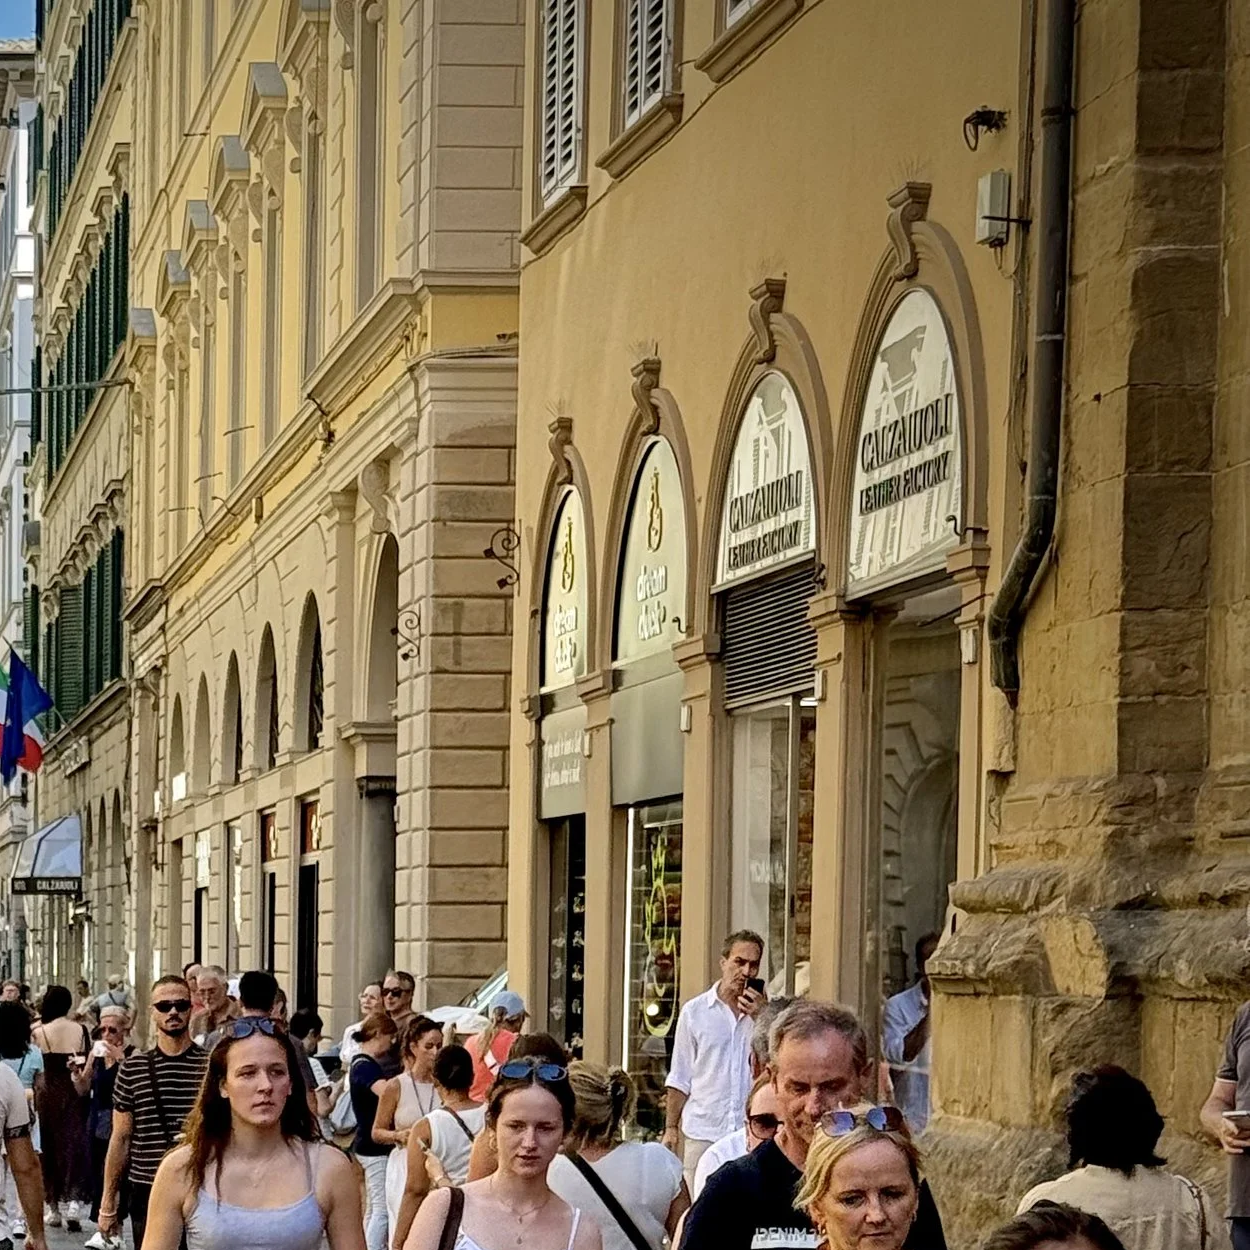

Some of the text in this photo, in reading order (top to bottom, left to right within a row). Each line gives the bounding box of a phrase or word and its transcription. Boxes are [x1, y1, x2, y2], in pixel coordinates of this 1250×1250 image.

[861, 393, 954, 474] CALZAIUOLI
[730, 470, 803, 533] CALZAIUOLI
[859, 450, 954, 516] LEATHER FACTORY
